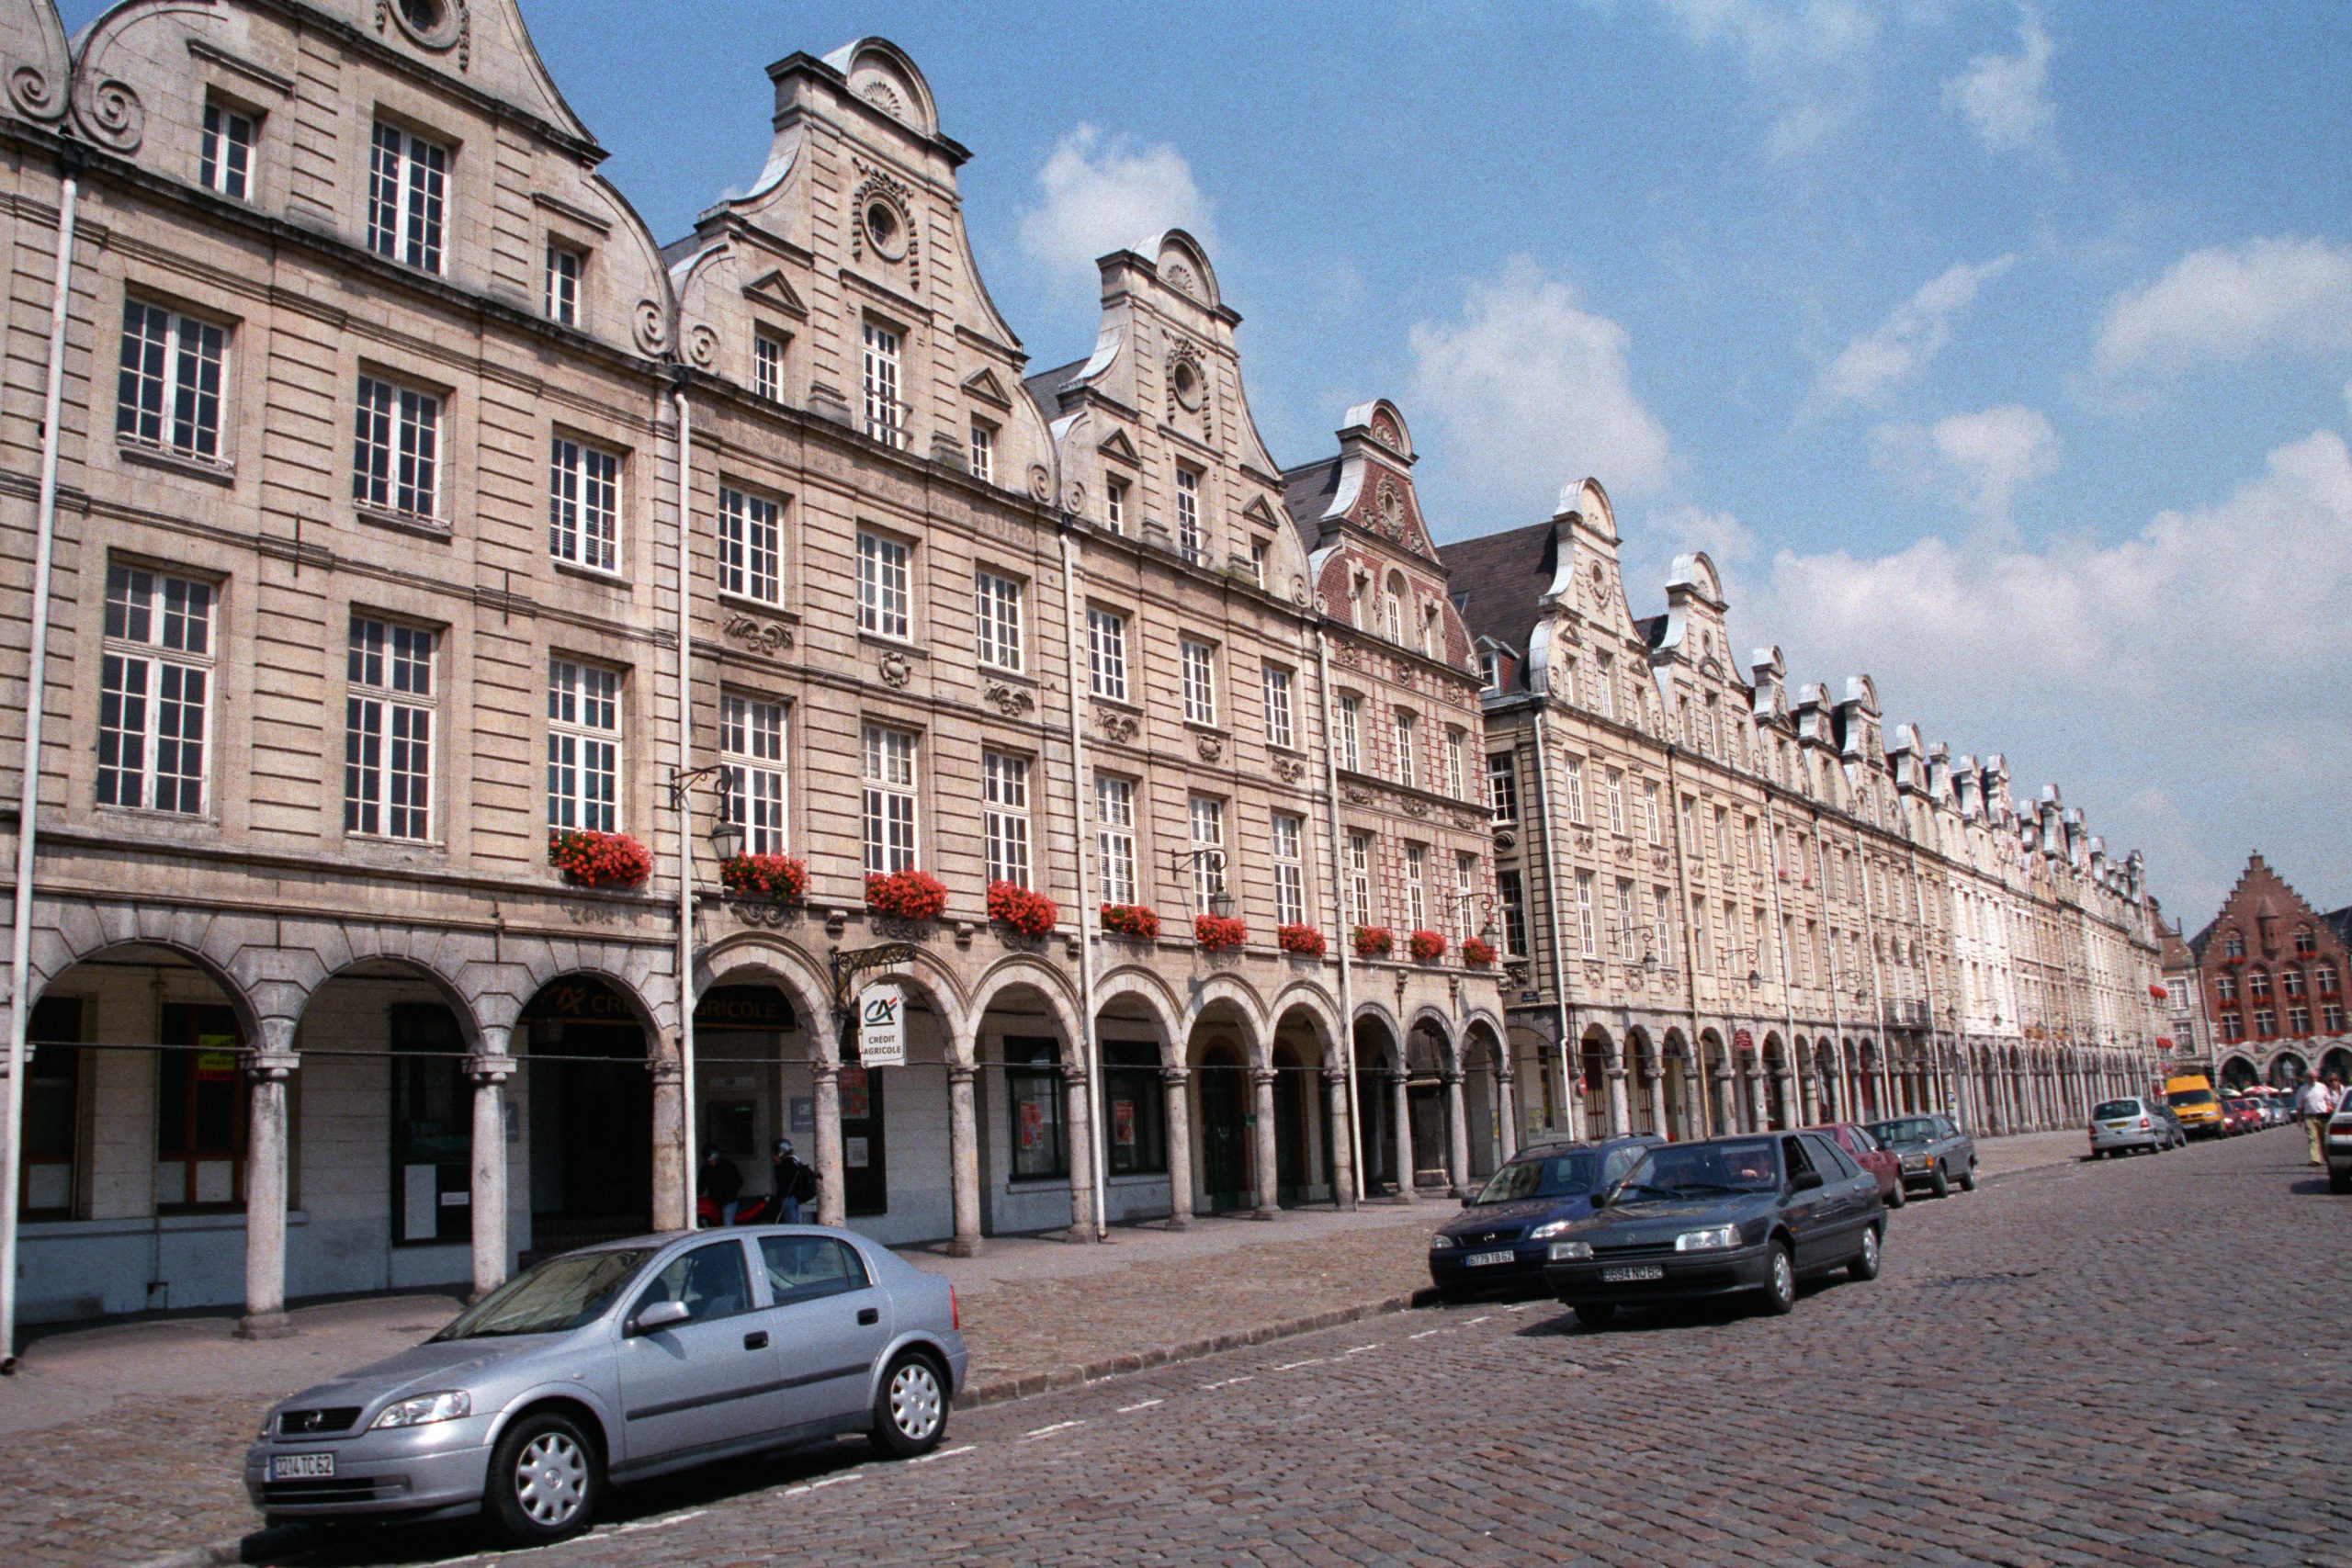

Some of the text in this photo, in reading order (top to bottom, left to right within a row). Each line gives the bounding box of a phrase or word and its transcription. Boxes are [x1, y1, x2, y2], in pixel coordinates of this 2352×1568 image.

[695, 998, 779, 1019] GRICOLE
[868, 1034, 896, 1045] CRÉDIT
[864, 1046, 901, 1055] AGRICOLE
